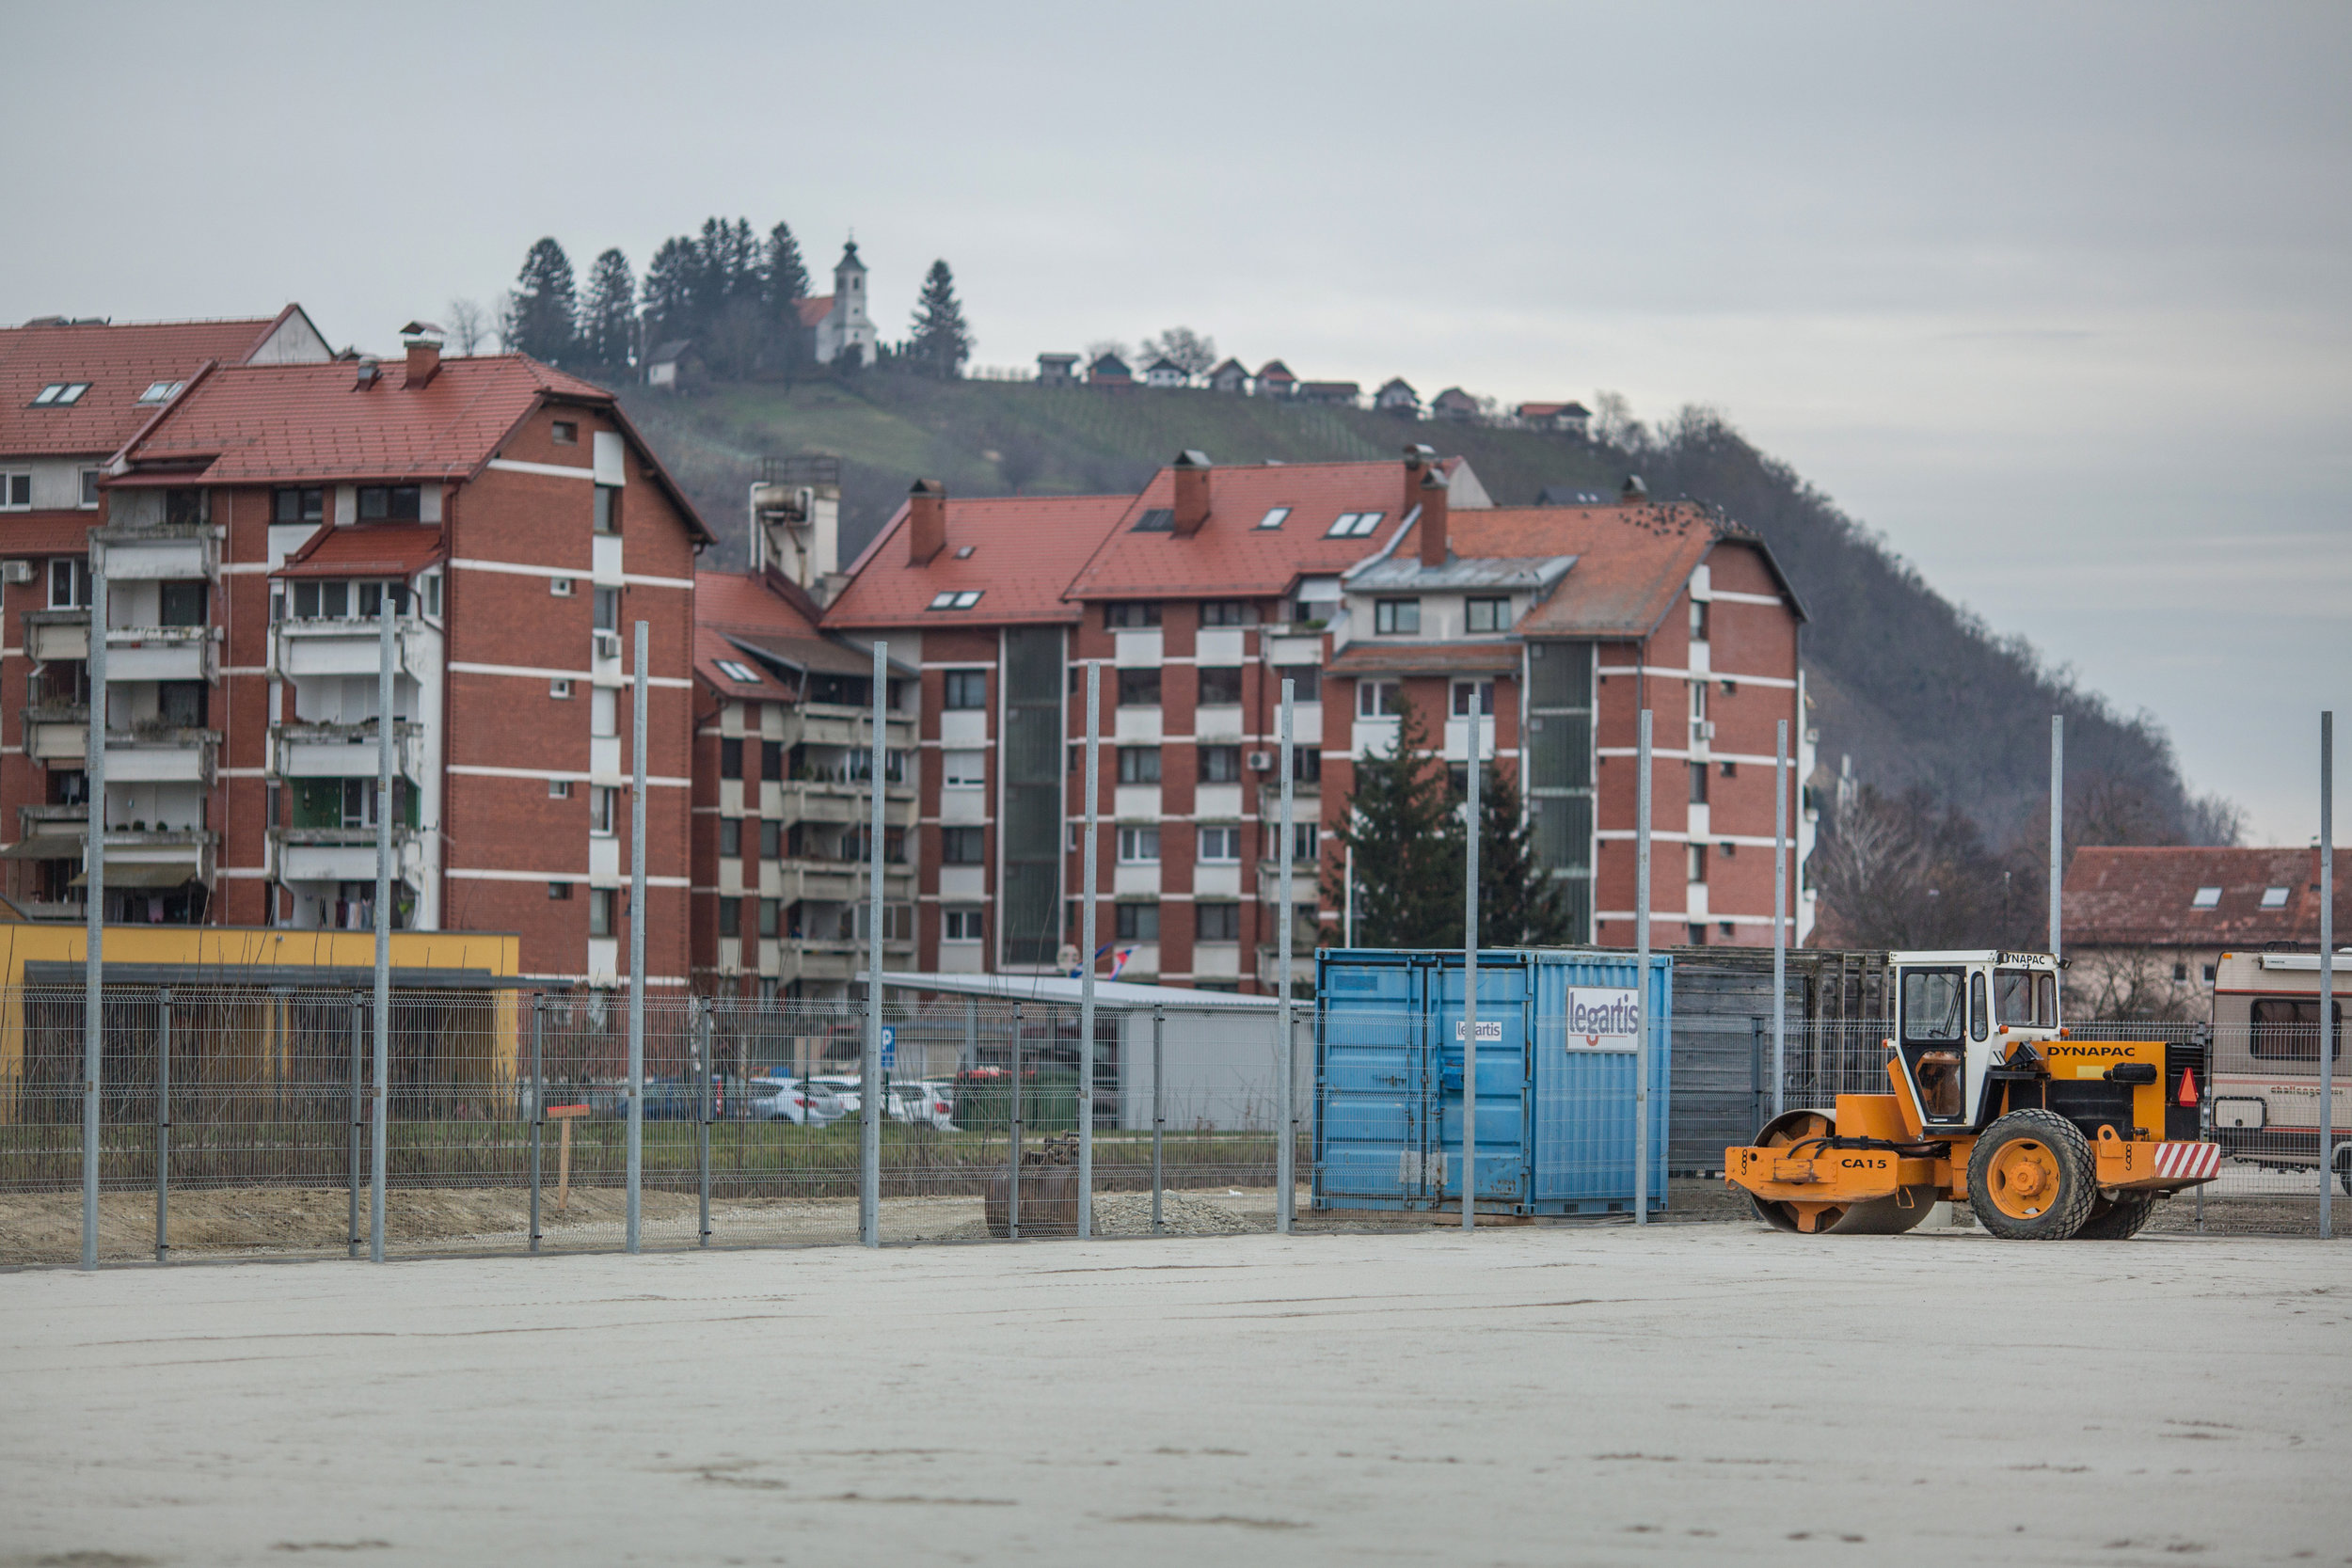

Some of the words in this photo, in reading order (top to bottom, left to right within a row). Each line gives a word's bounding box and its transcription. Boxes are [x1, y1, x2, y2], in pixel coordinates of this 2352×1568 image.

[2004, 954, 2045, 965] YNAPAC
[1569, 991, 1639, 1047] legartis
[1457, 1022, 1501, 1037] leartis
[882, 1029, 892, 1050] P
[2047, 1046, 2136, 1056] DYNAPAC
[2270, 1086, 2322, 1098] challenge
[1841, 1158, 1887, 1169] CA15
